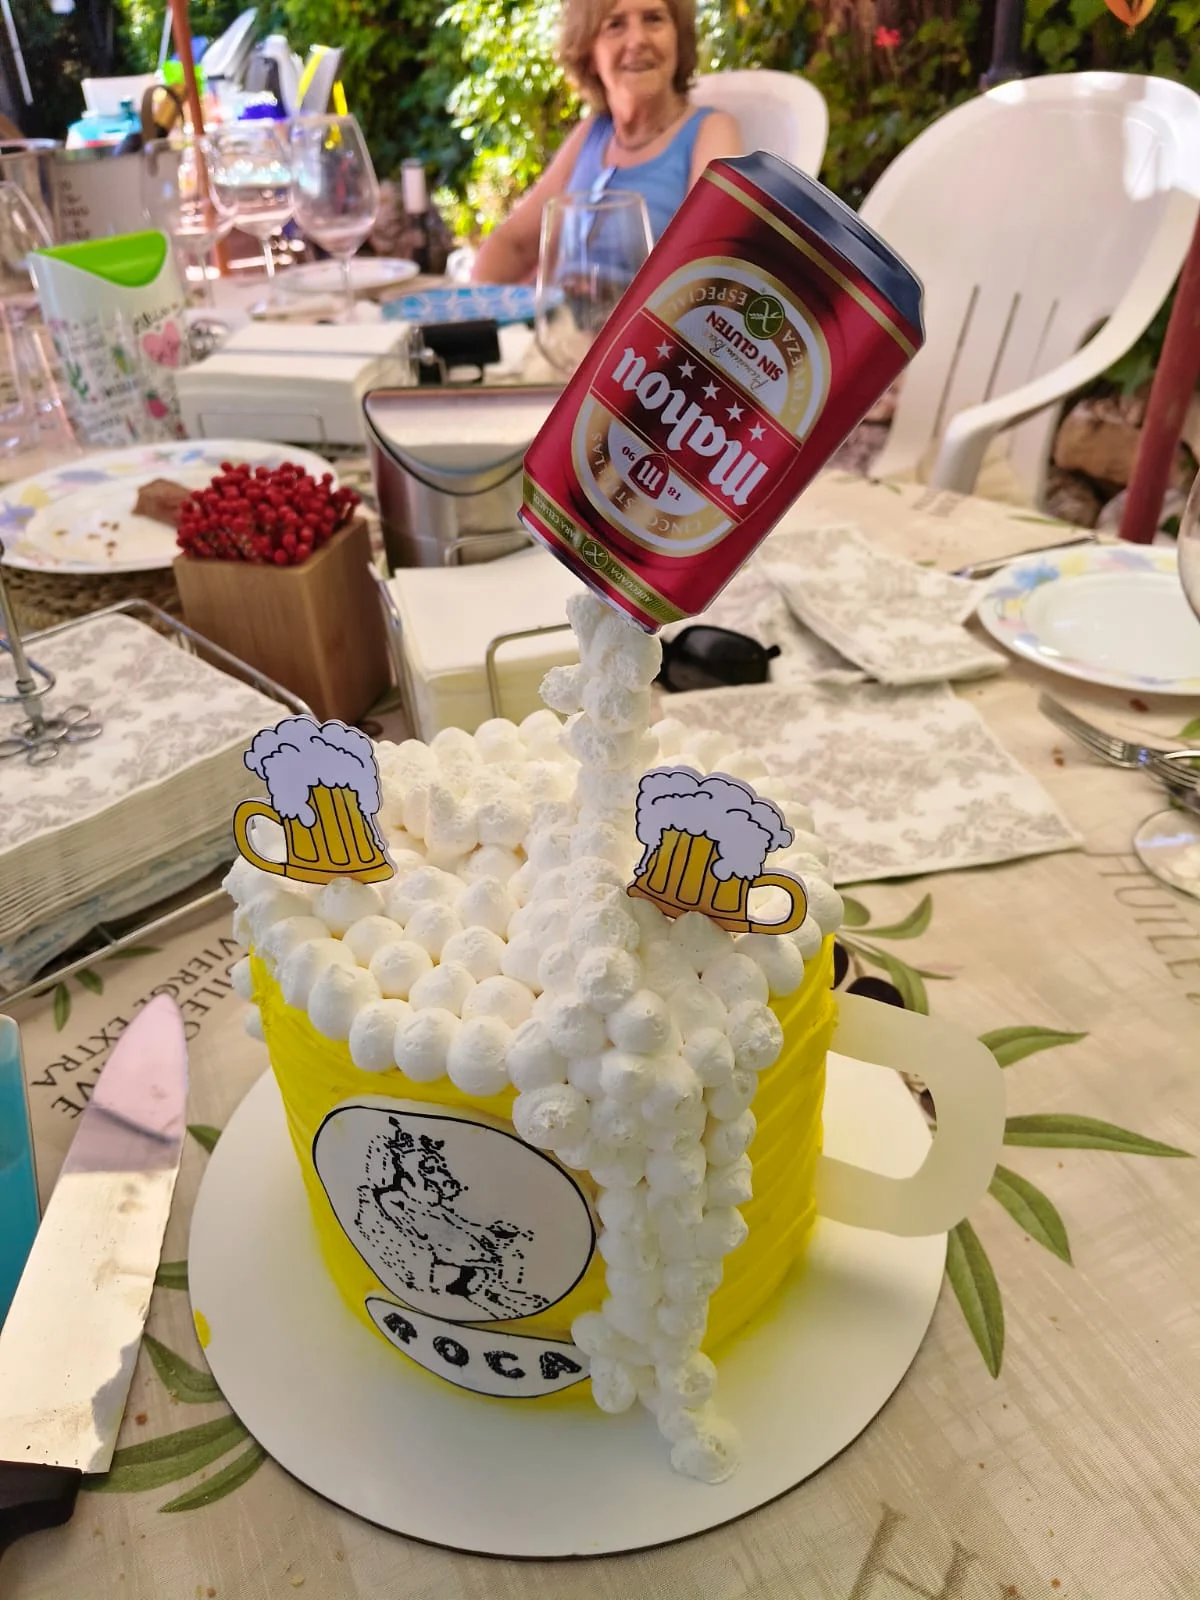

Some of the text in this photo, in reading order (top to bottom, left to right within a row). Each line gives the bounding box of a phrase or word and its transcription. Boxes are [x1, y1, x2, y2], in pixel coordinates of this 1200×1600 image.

[705, 310, 784, 381] SIN GLUTEN
[612, 347, 769, 506] Mahou
[621, 445, 636, 462] 90
[667, 486, 682, 502] 18
[31, 1016, 130, 1087] EXTRA
[382, 1311, 583, 1380] ROCA
